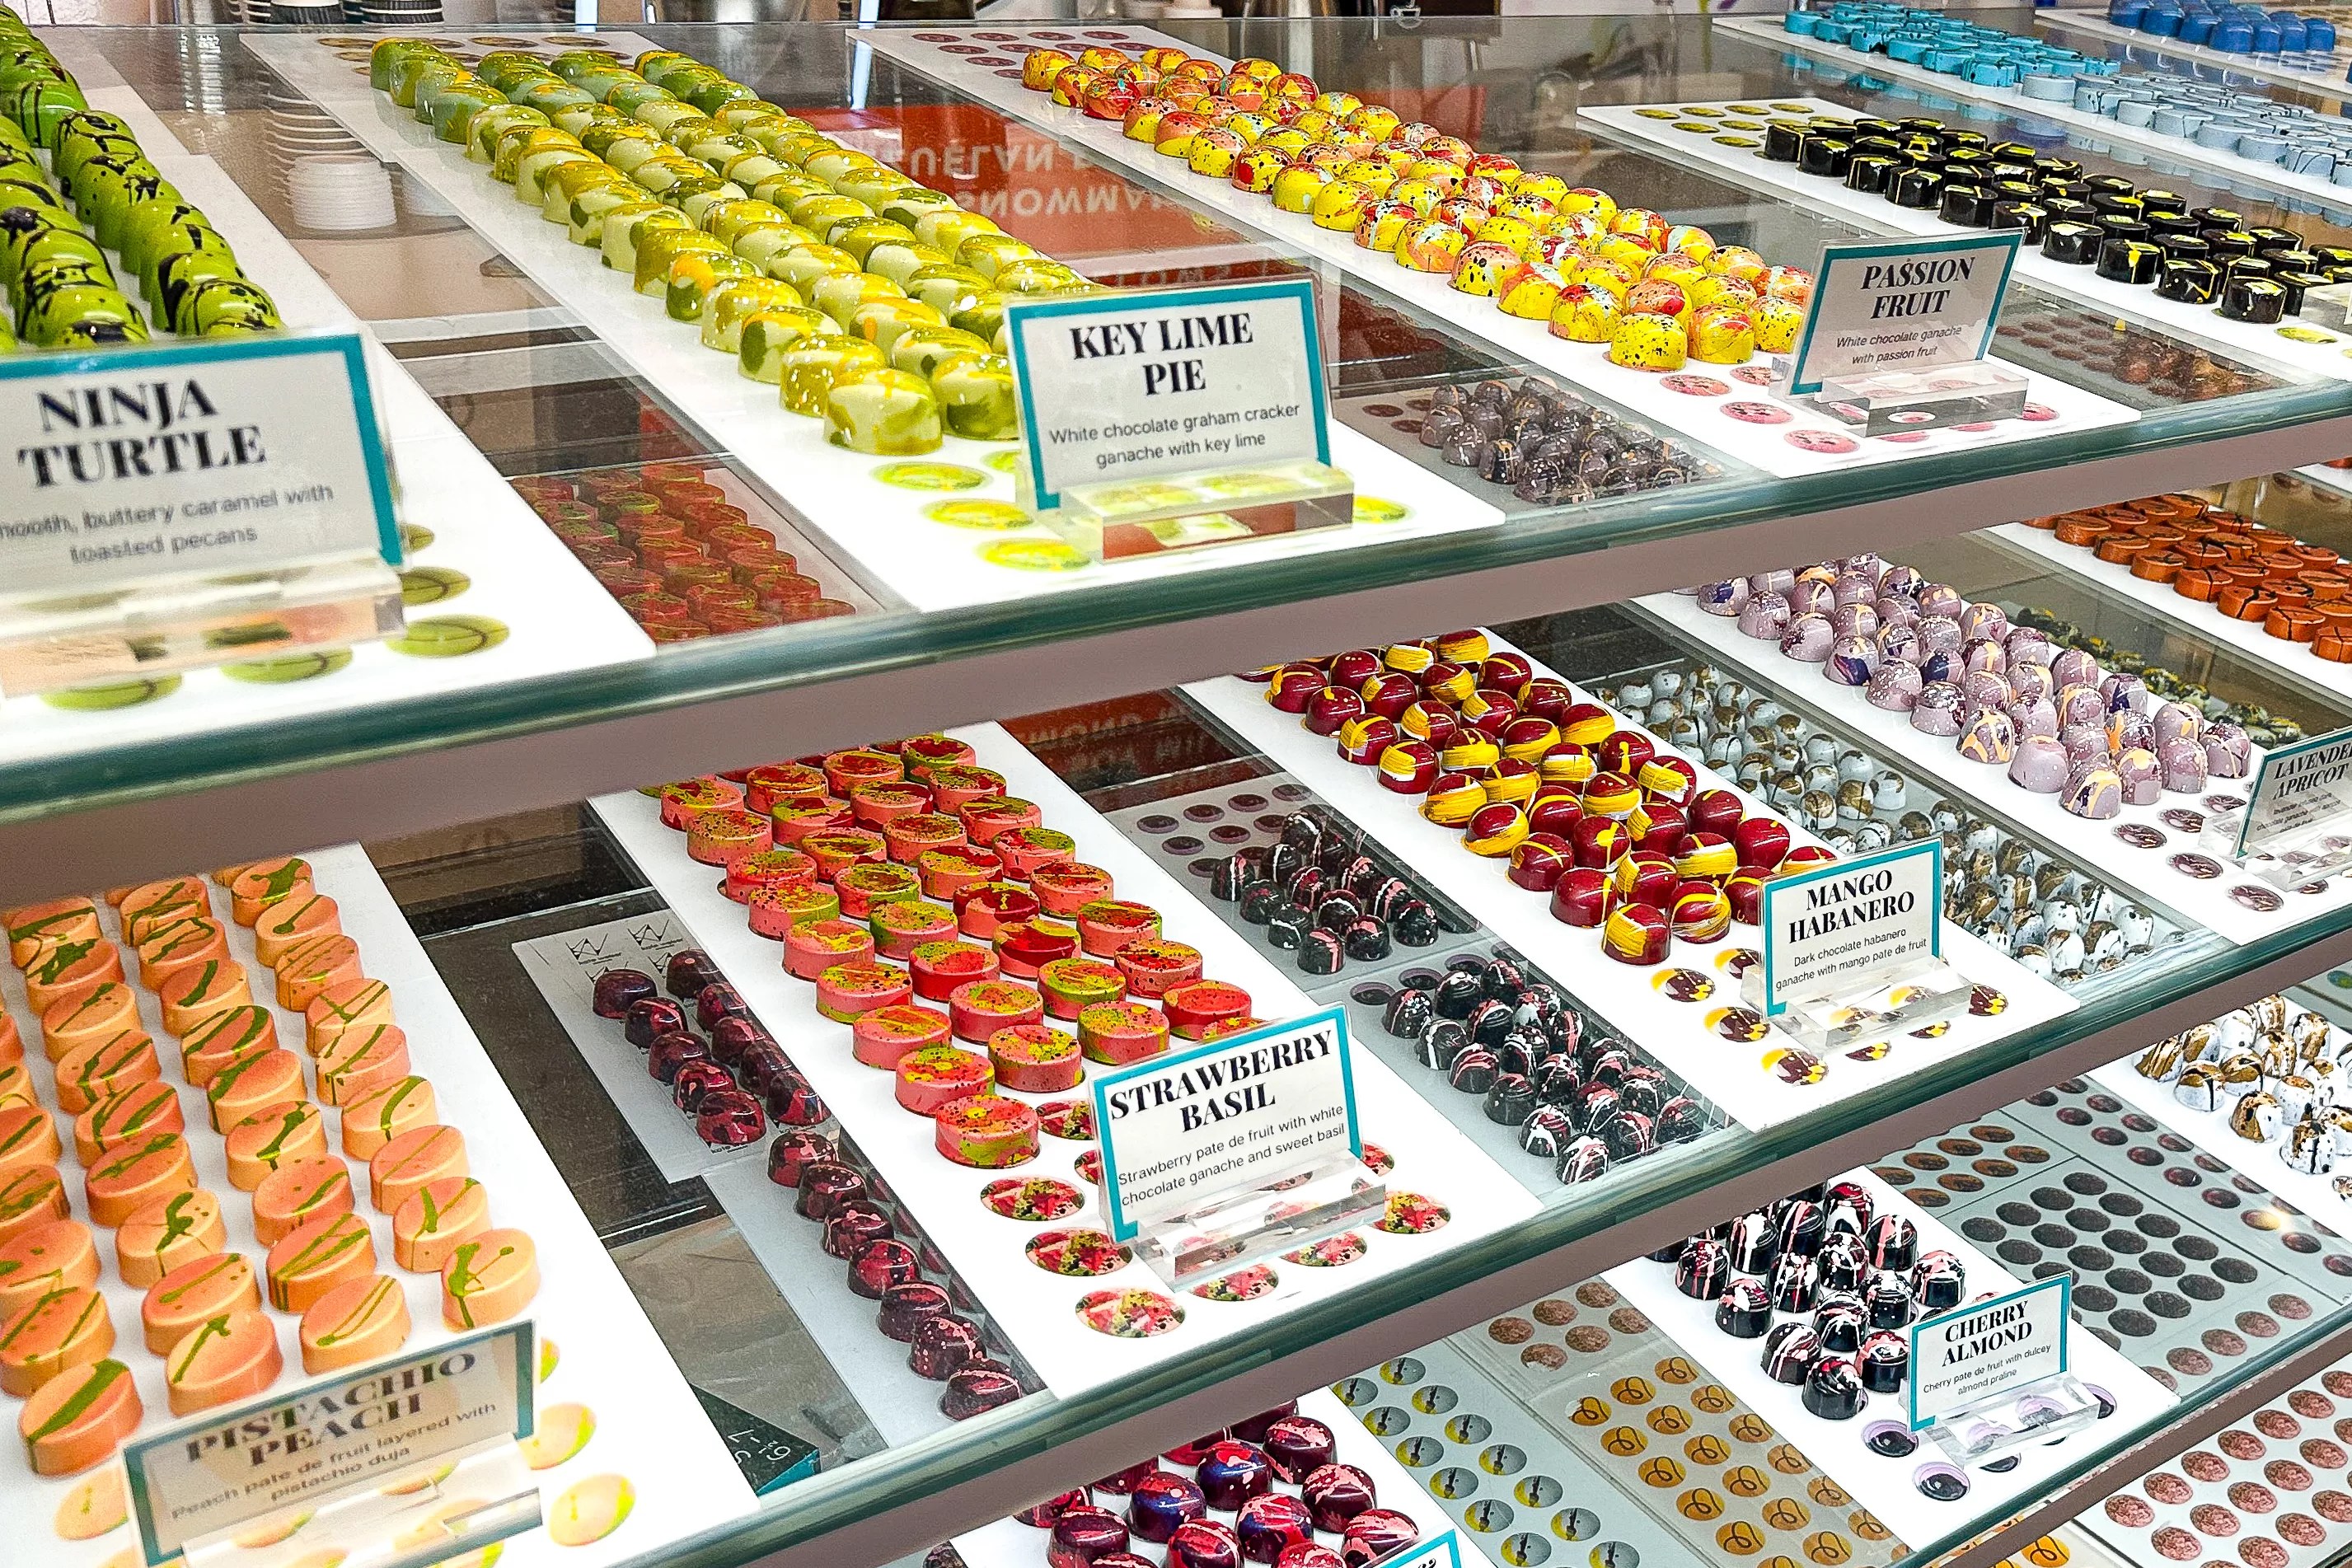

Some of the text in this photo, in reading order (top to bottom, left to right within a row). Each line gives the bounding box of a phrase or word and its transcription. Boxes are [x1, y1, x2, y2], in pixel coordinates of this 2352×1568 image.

[1860, 257, 1975, 289] PASSION
[1870, 290, 1950, 319] FRUIT
[1070, 312, 1253, 359] KEY LIME
[1837, 326, 1961, 349] White chocolate ganache
[1852, 346, 1937, 364] with passion fruit
[1142, 358, 1206, 396] PIE
[36, 377, 218, 432] NINJA
[1049, 404, 1300, 444] White chocolate graham cracker
[16, 424, 268, 489] TURTLE
[1096, 432, 1266, 470] ganache with key lime
[82, 505, 175, 529] buttery
[181, 492, 279, 517] caramel
[283, 483, 334, 505] with
[69, 527, 258, 564] toasted pecans
[2272, 763, 2350, 800] APRICOT
[2273, 742, 2352, 780] LAVENDE
[1806, 869, 1892, 910] MANGO
[1788, 891, 1914, 943] HABANERO
[1775, 938, 1927, 991] ganache with mango pate de fruit
[1794, 929, 1906, 967] Dark chocolate habanero
[1110, 1029, 1332, 1120] STRAWBERRY
[1179, 1082, 1275, 1133] BASIL
[1118, 1105, 1343, 1186] Strawberry pate de fruit with white
[1122, 1123, 1346, 1206] chocolate ganache and sweet basil
[1945, 1300, 2029, 1342] CHERRY
[1942, 1322, 2032, 1367] ALMOND
[1923, 1344, 2051, 1393] Cherry pate de fruit with dulcey
[1957, 1369, 2017, 1395] almond praline
[185, 1351, 476, 1463] PISTACHIO
[250, 1392, 422, 1467] PEACH
[171, 1403, 496, 1519] Peach pate de fruit layered with
[270, 1446, 411, 1502] pistachio duja
